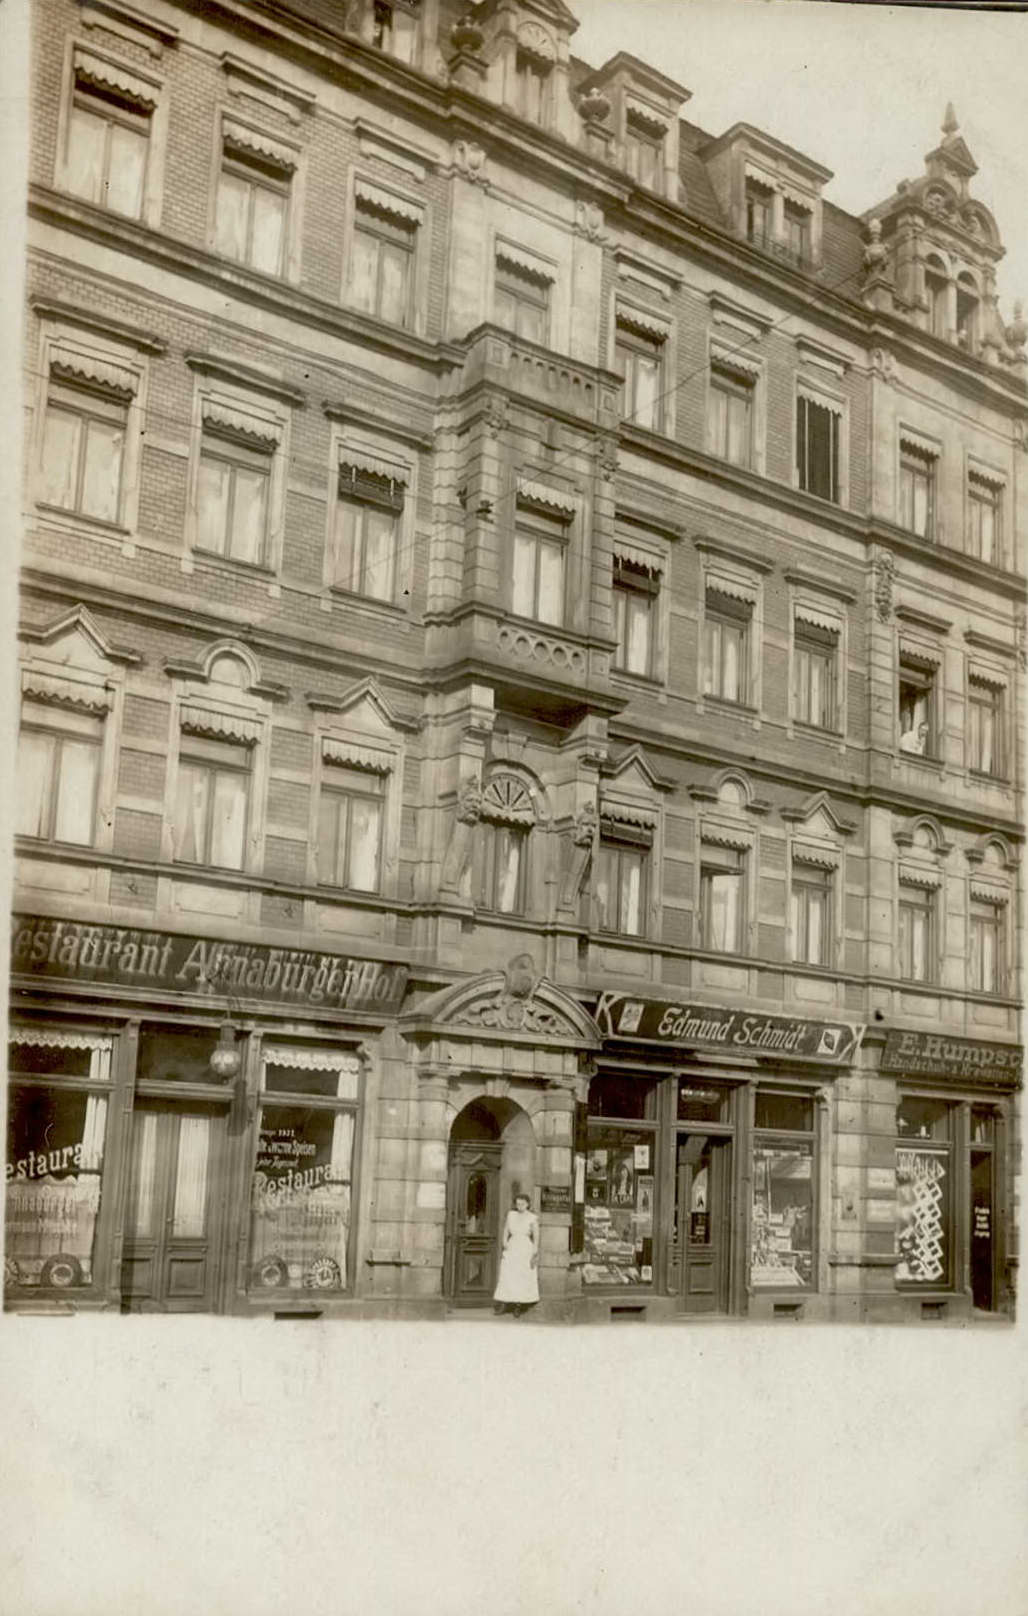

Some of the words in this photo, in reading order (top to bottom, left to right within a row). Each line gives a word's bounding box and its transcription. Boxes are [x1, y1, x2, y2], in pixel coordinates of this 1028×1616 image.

[12, 922, 172, 976] estaurant
[658, 1006, 736, 1040] Edmund
[733, 1017, 807, 1051] Schmidt
[922, 1035, 1022, 1068] Humpsc
[7, 1143, 93, 1182] estaura
[253, 1163, 335, 1195] Restaura
